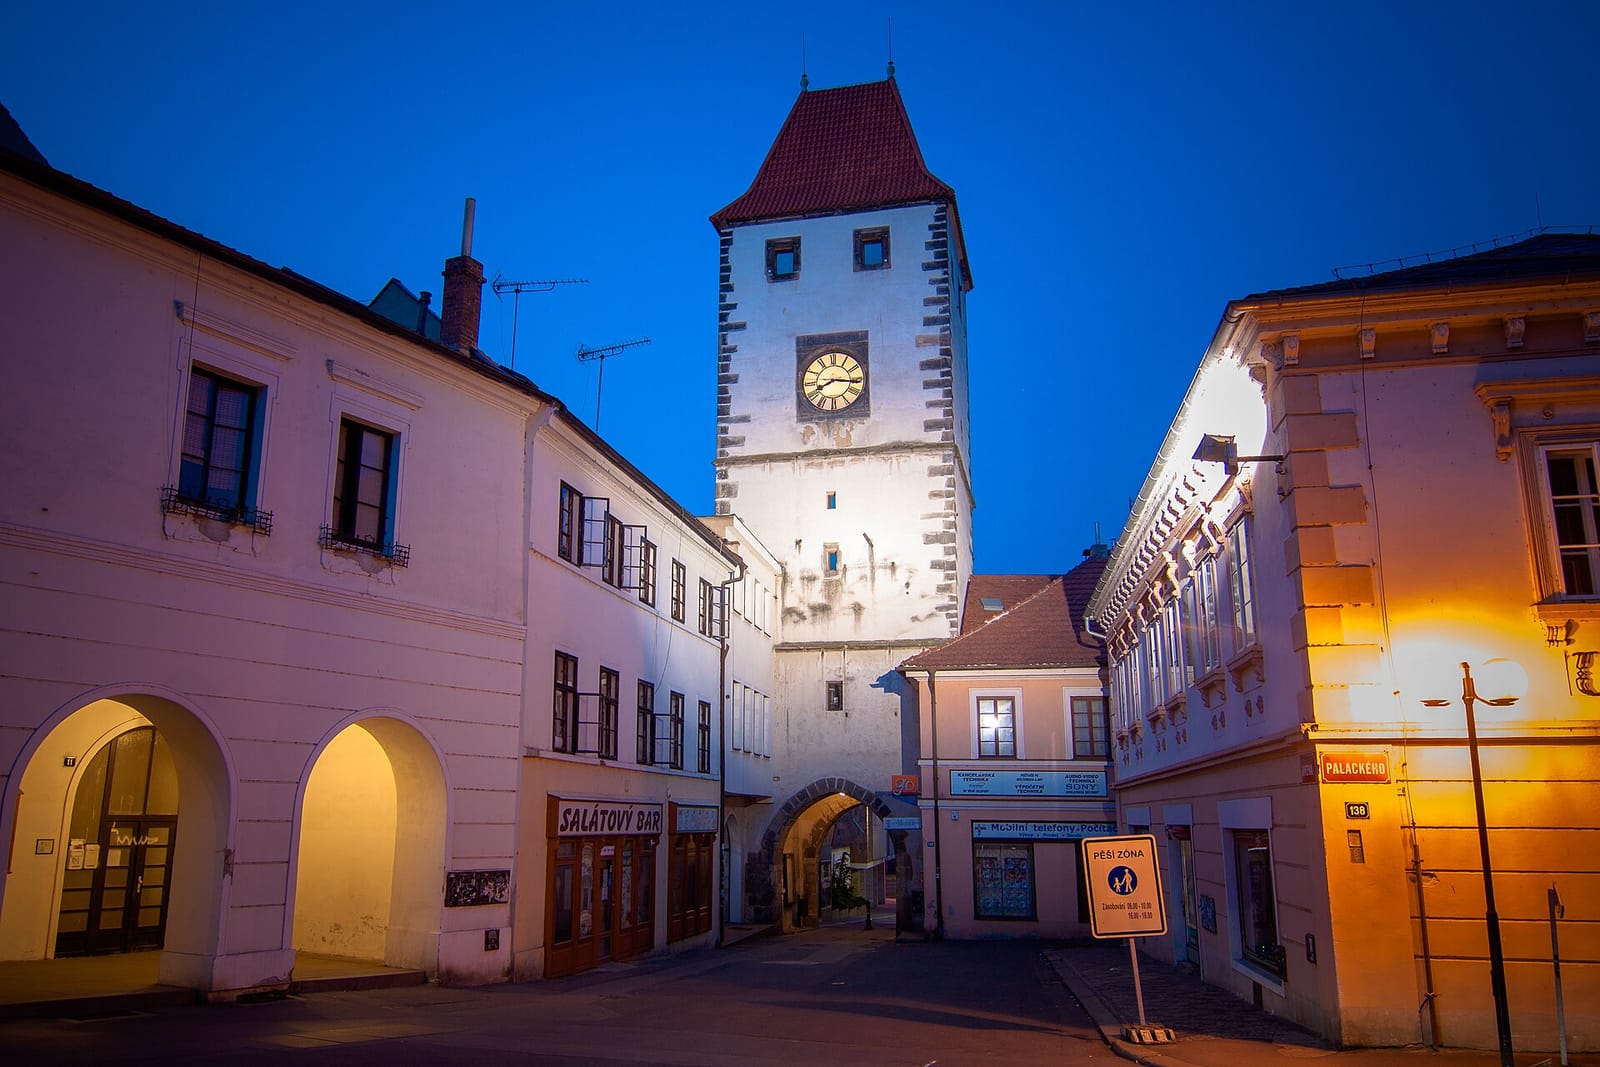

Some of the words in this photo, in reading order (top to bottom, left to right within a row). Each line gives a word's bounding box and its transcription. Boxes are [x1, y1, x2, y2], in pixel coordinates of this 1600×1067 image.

[1326, 761, 1386, 775] PALACKÉHO
[1065, 783, 1097, 791] SONY
[1349, 805, 1366, 816] 138
[560, 804, 633, 832] SALÁTOVÝ
[636, 810, 660, 832] BAR
[1033, 823, 1075, 834] telefony
[1093, 850, 1115, 860] PĚŠÍ
[1117, 849, 1145, 859] ZÓNA
